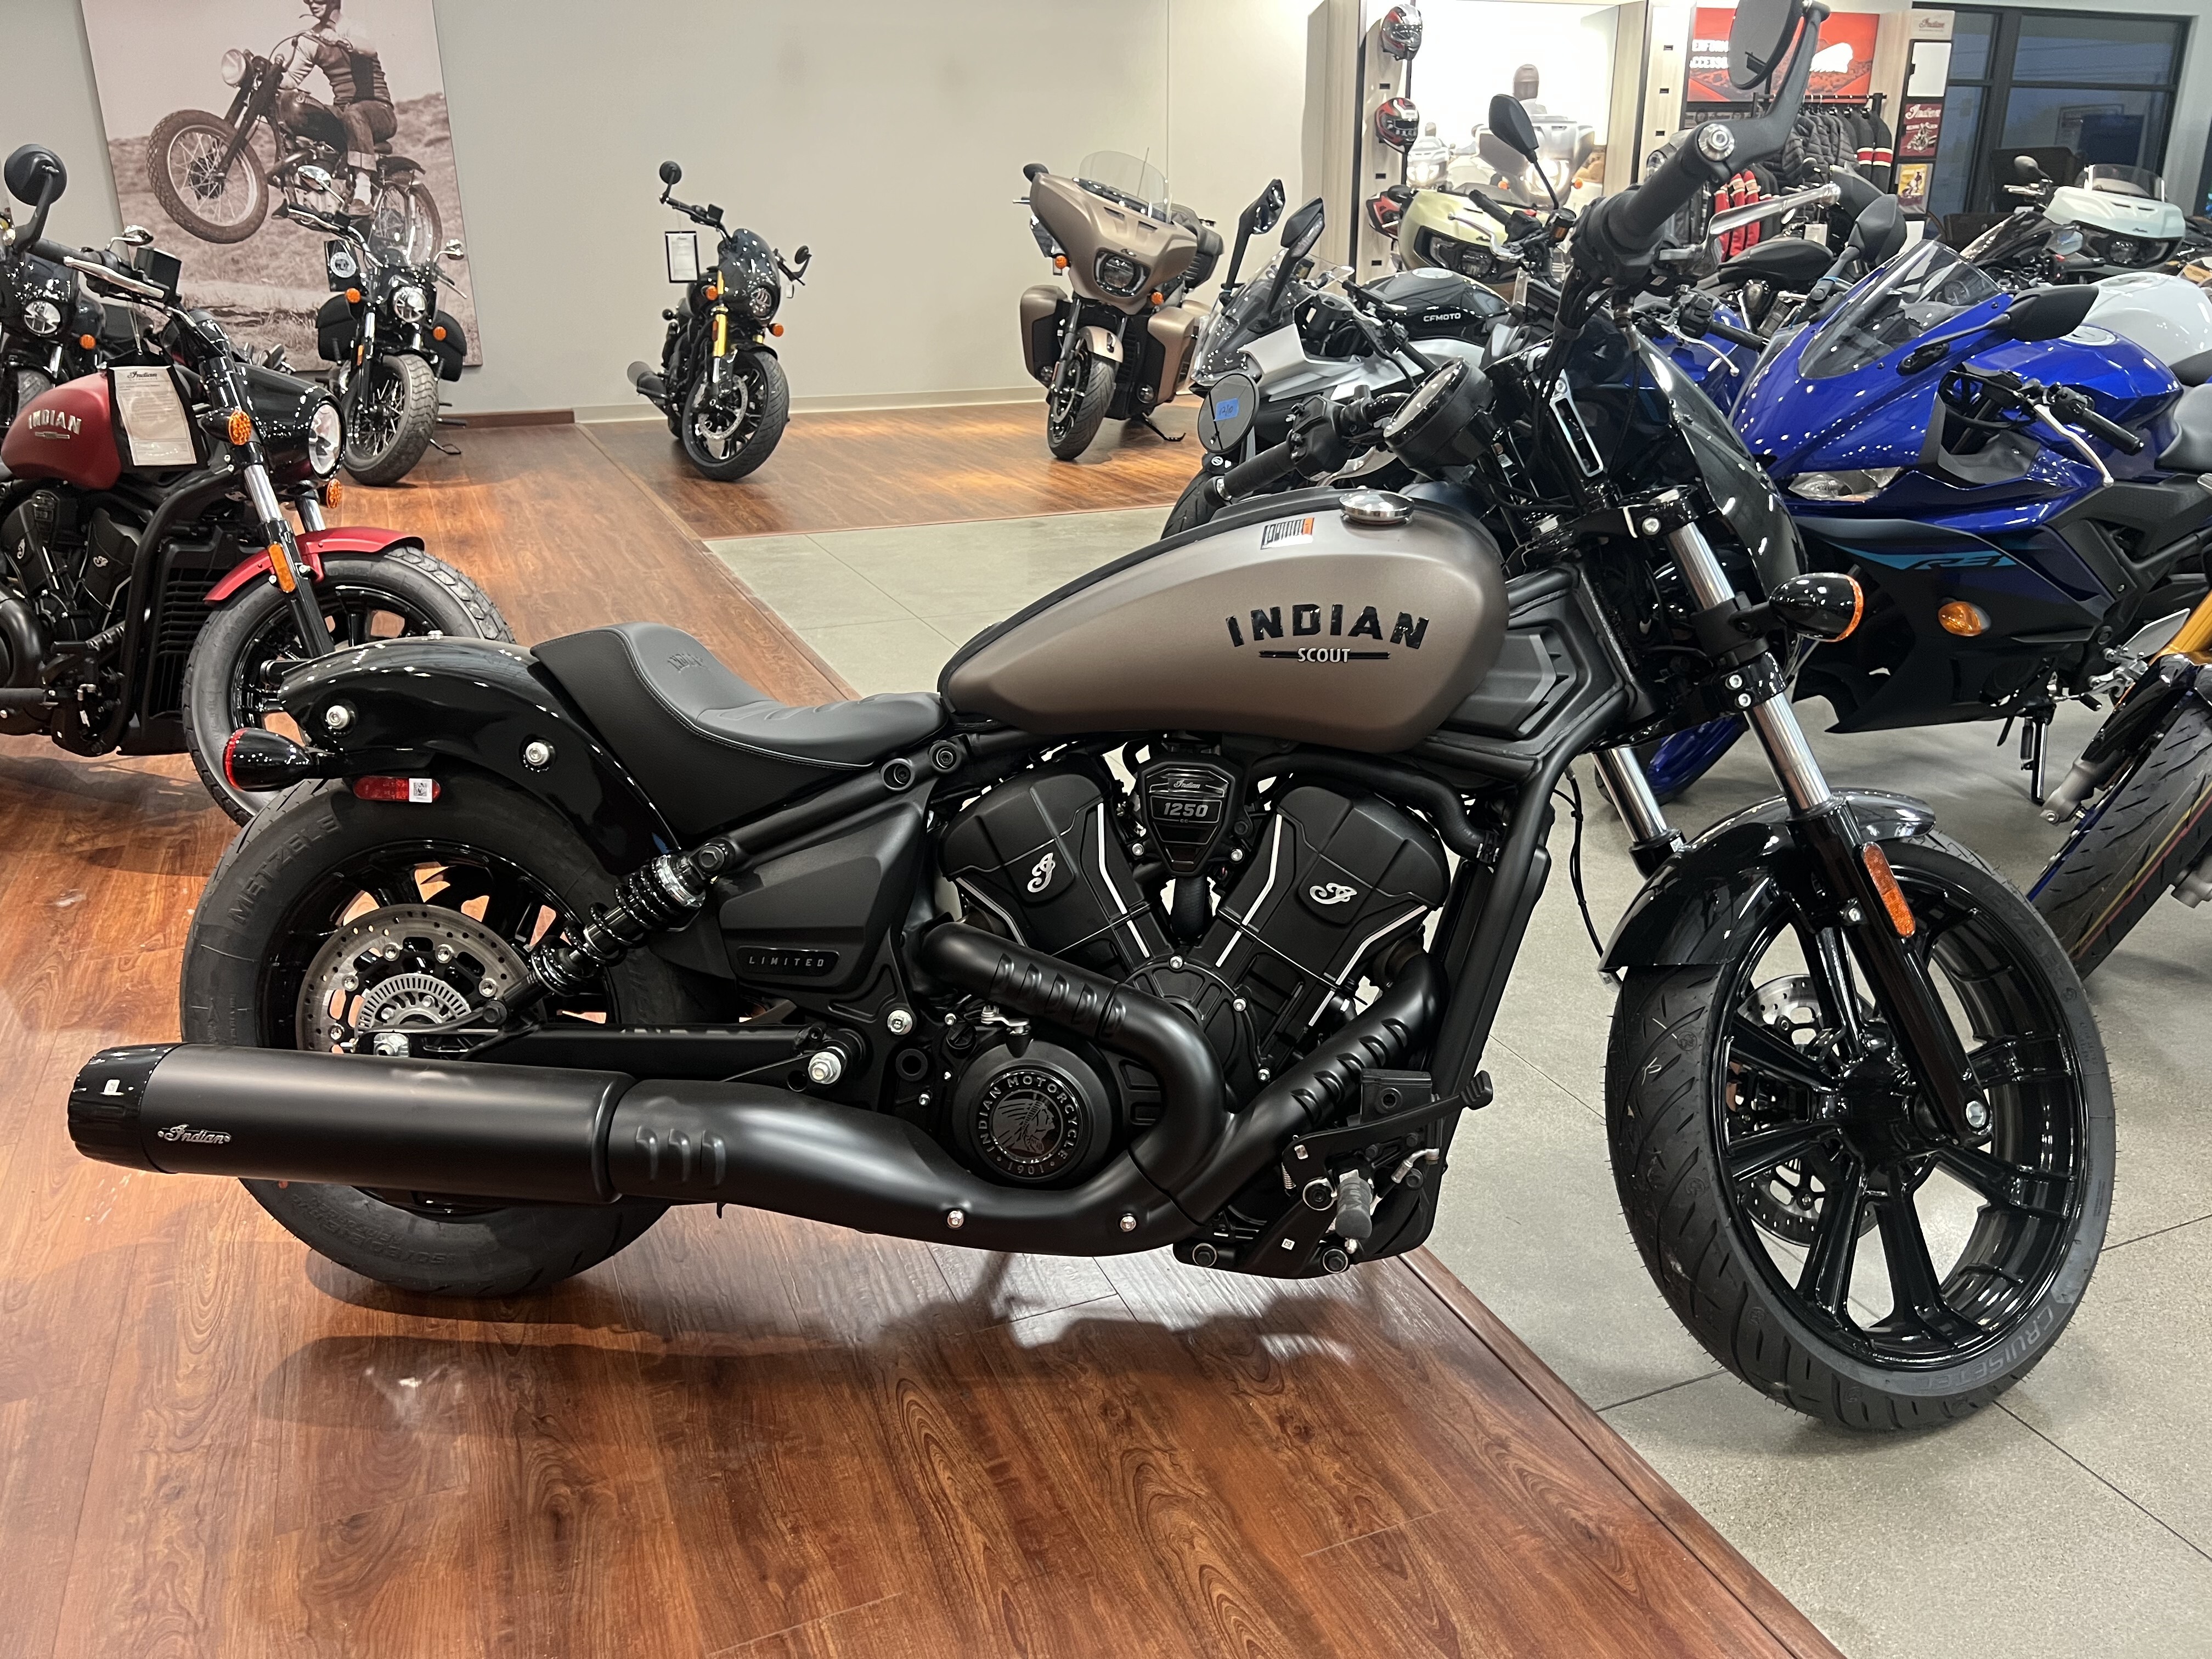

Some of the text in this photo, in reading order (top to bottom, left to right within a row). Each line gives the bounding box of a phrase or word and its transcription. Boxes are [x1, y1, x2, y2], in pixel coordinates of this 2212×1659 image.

[1423, 312, 1461, 323] CFMOTO
[29, 409, 82, 435] INDIAN
[1226, 603, 1429, 650] INDIAN
[1297, 647, 1351, 663] SCOUT
[1173, 780, 1201, 789] Indian
[1163, 803, 1209, 817] 1250
[749, 956, 825, 967] LIMITED
[978, 1075, 1079, 1160] INDIAN MOTORCYCLE
[163, 1124, 225, 1144] Indian
[1008, 1161, 1045, 1175] 1901
